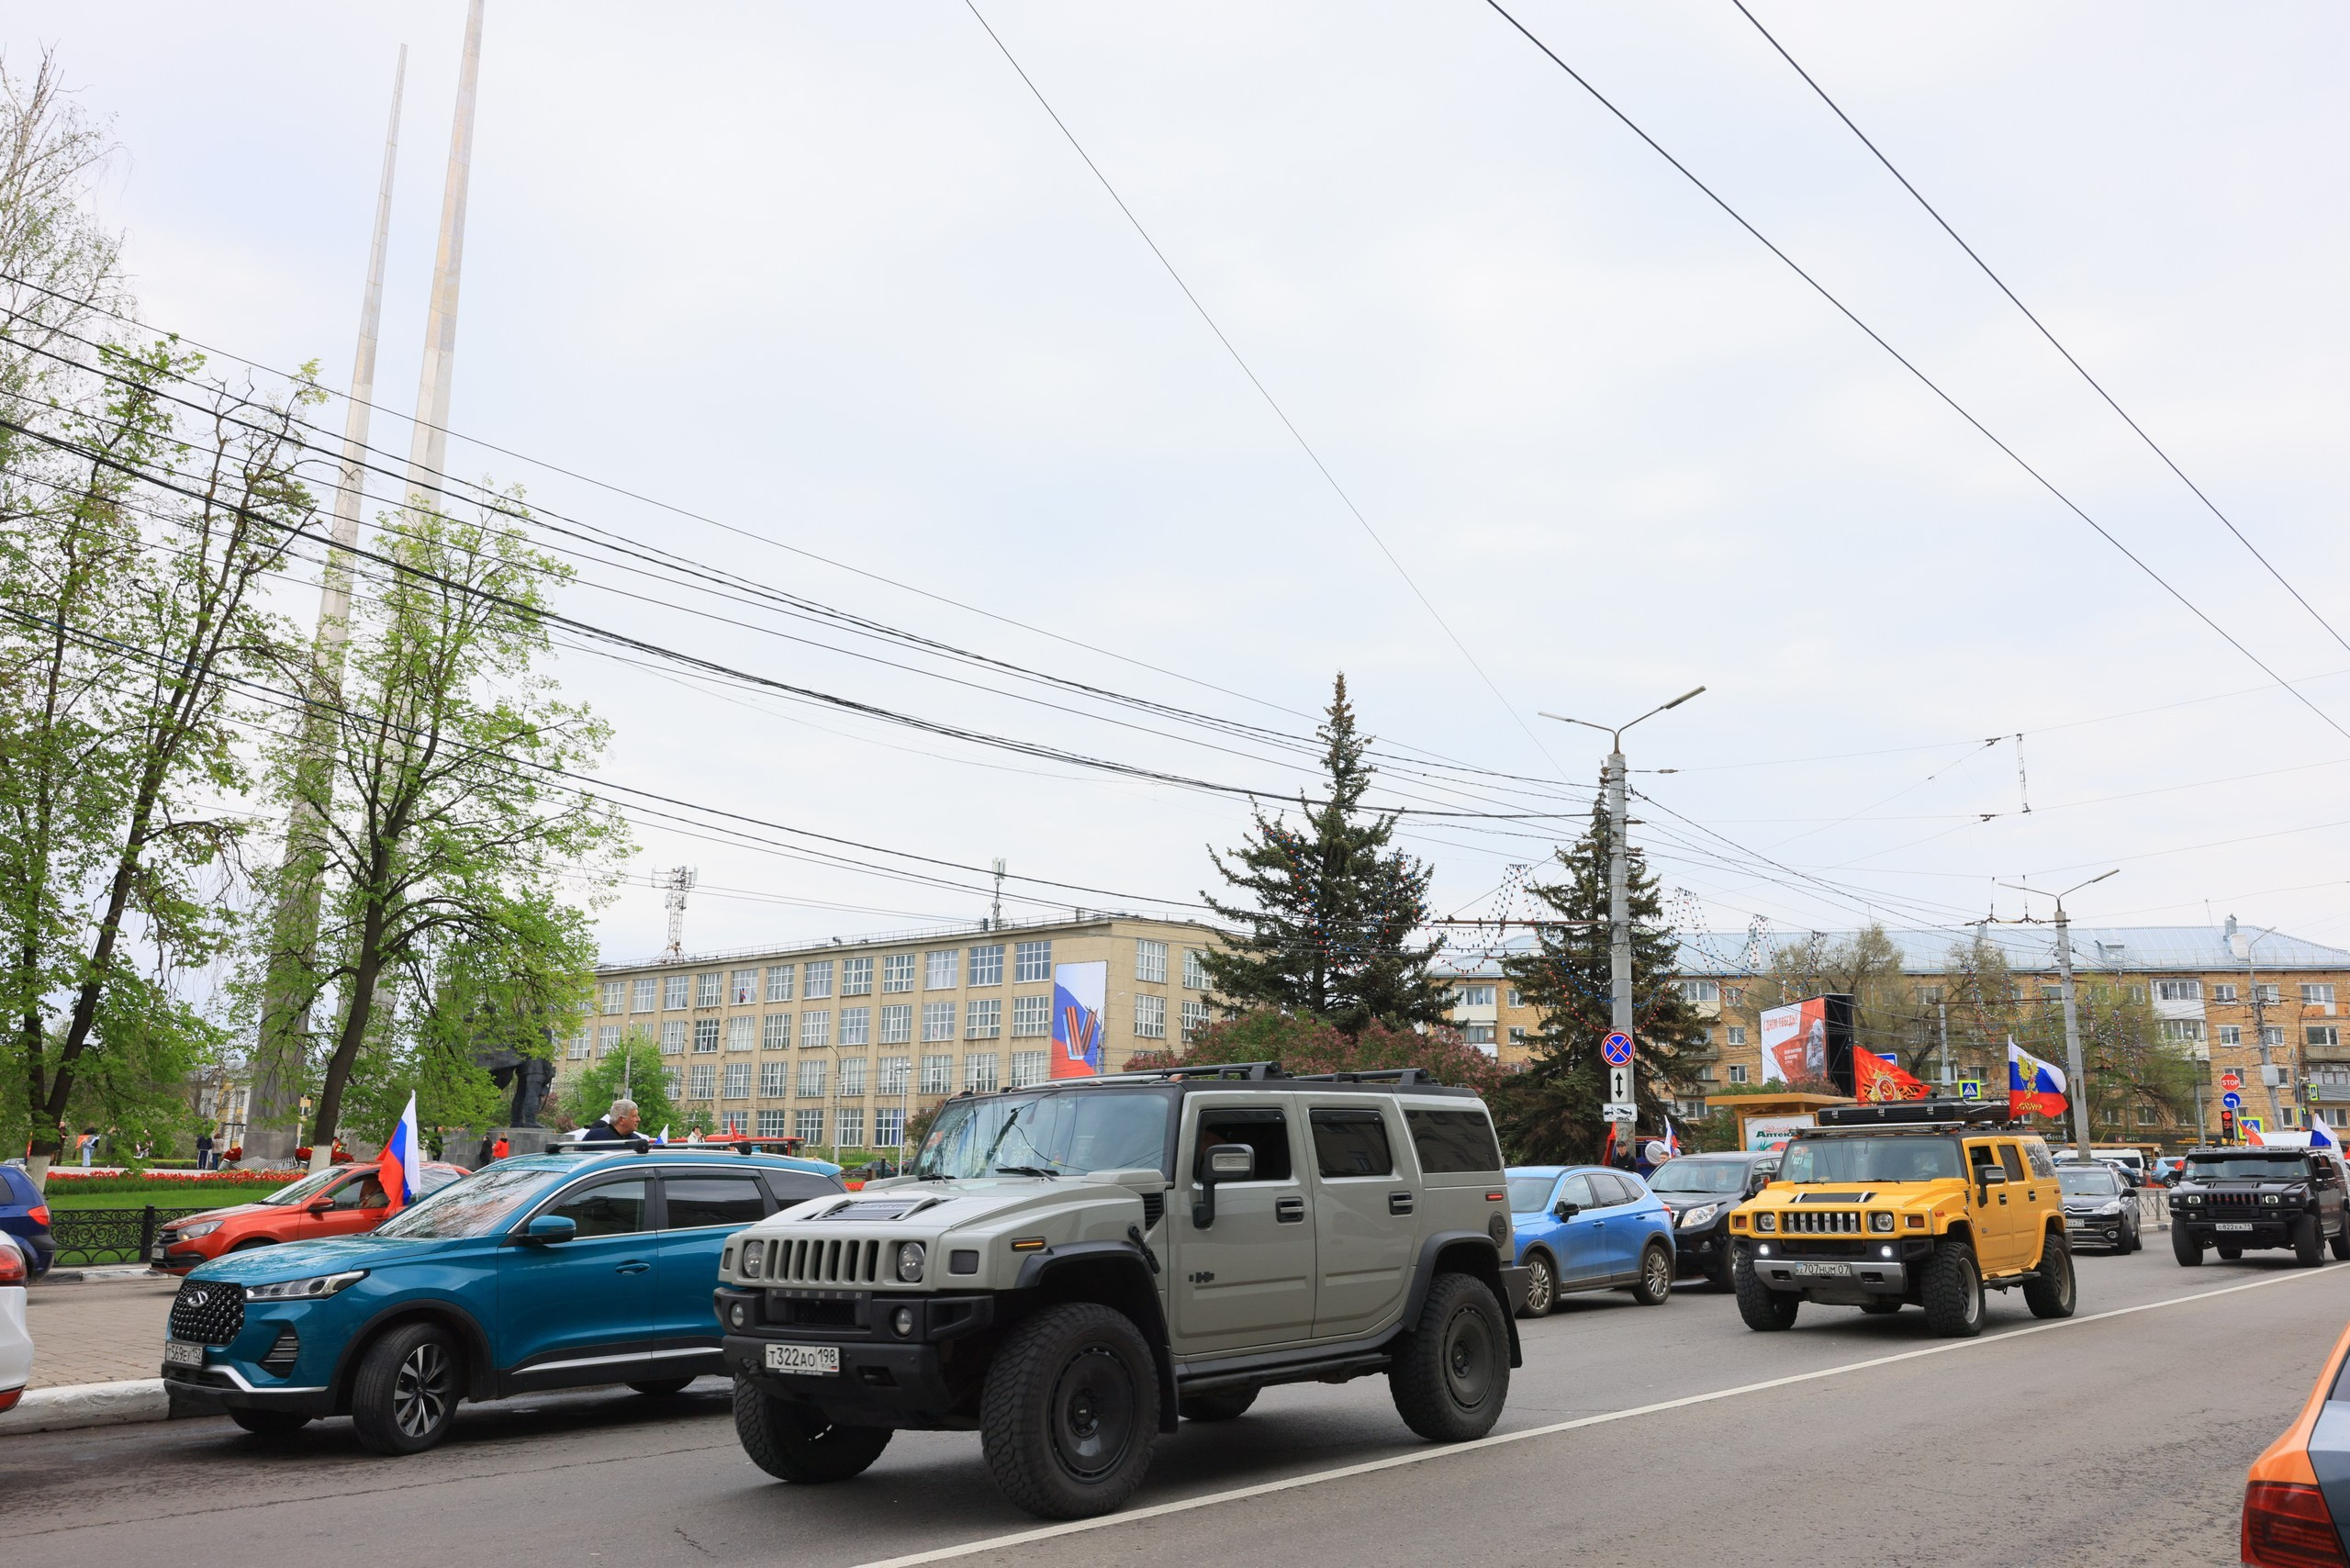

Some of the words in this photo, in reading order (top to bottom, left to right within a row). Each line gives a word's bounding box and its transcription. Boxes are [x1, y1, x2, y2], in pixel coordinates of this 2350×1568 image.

[1839, 1265, 1849, 1273] 07
[772, 1290, 862, 1299] HUMMER
[768, 1347, 815, 1367] Т322АО
[818, 1349, 836, 1362] 198
